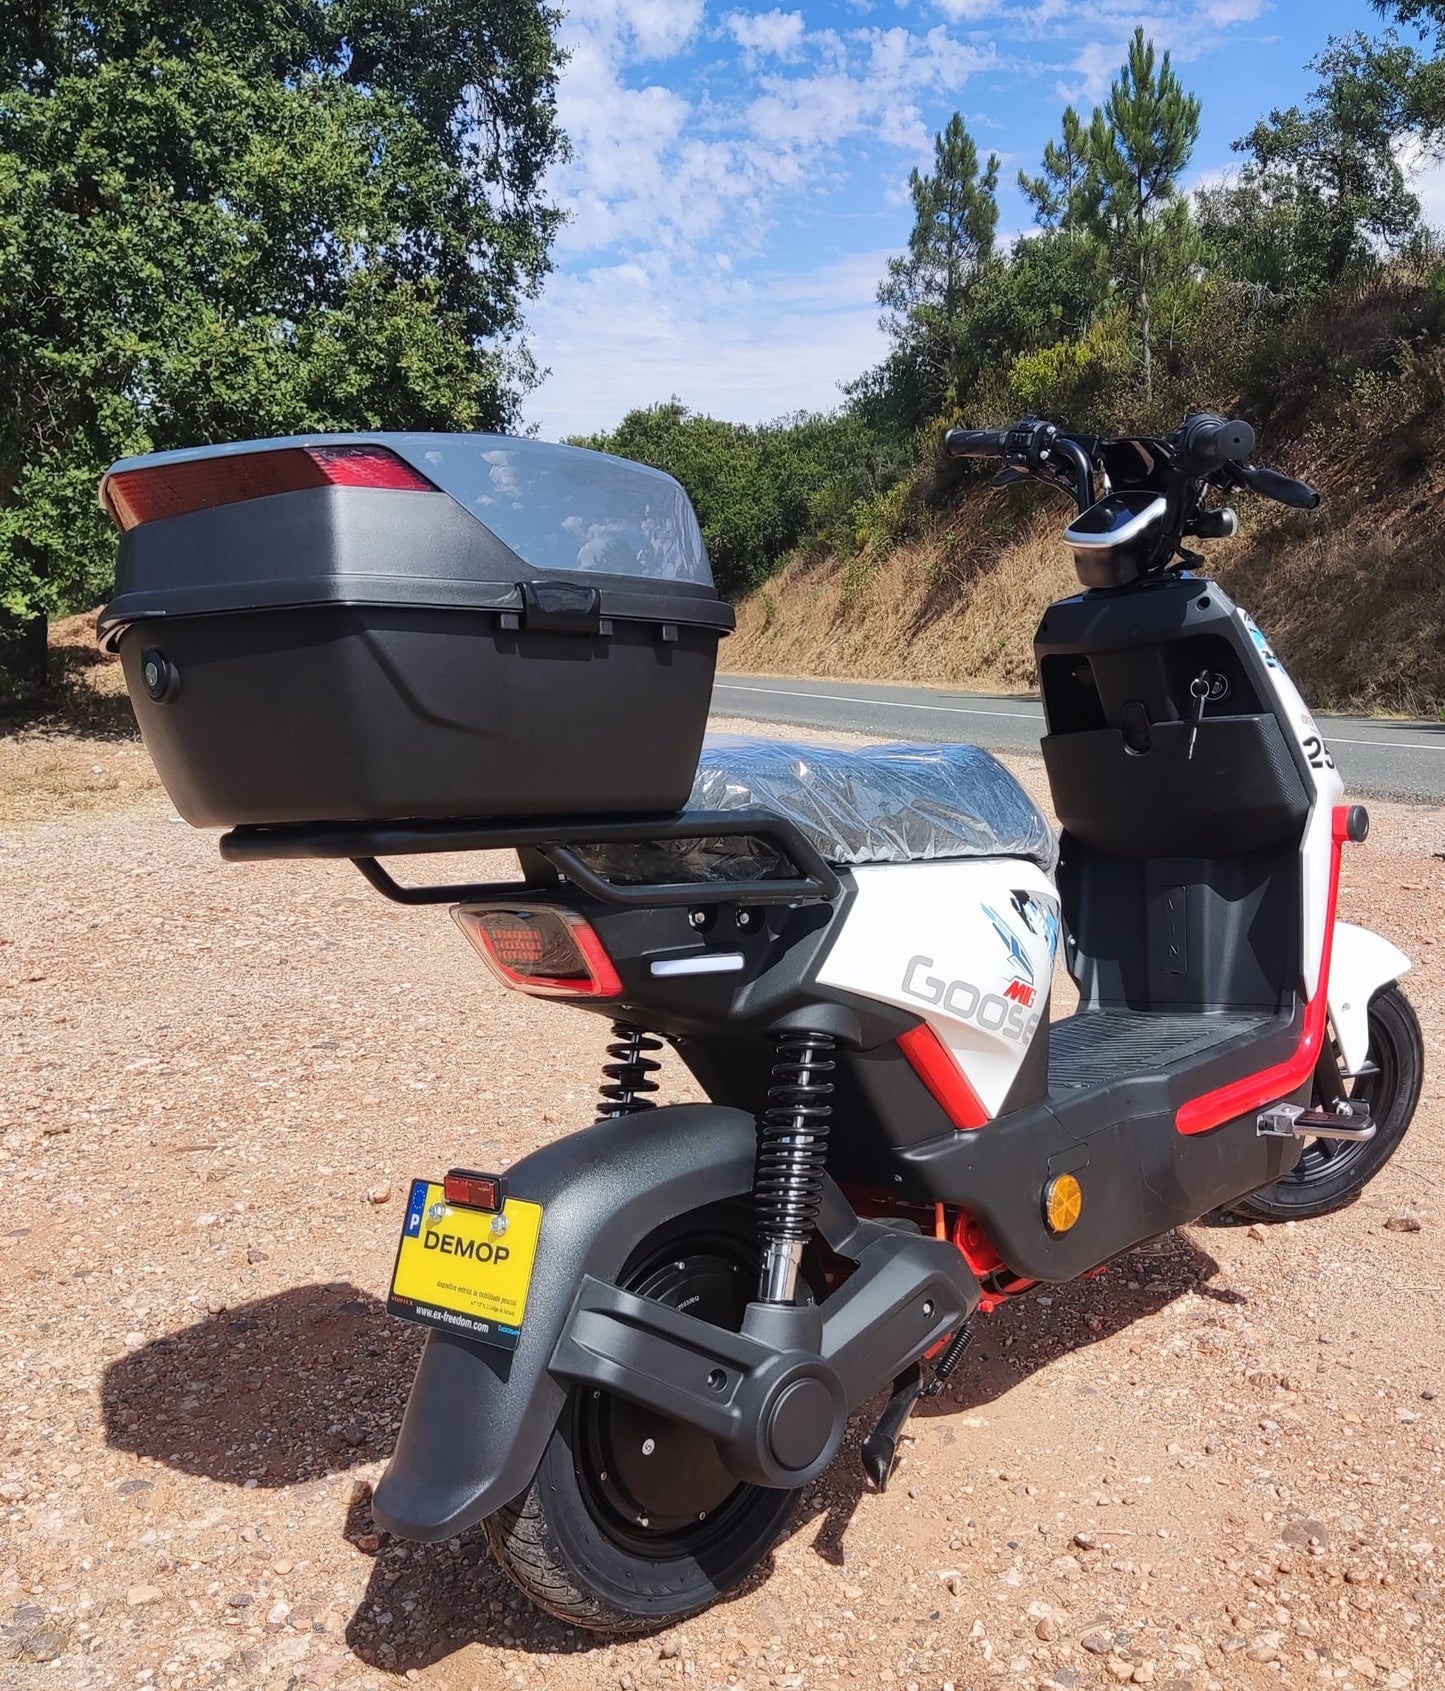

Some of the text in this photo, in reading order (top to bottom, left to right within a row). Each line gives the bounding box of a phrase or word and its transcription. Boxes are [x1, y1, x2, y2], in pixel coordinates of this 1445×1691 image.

[1003, 981, 1037, 1008] MIG
[409, 1214, 420, 1231] P
[423, 1230, 510, 1265] DEMOP
[415, 1305, 489, 1333] www.ex-freedom.com
